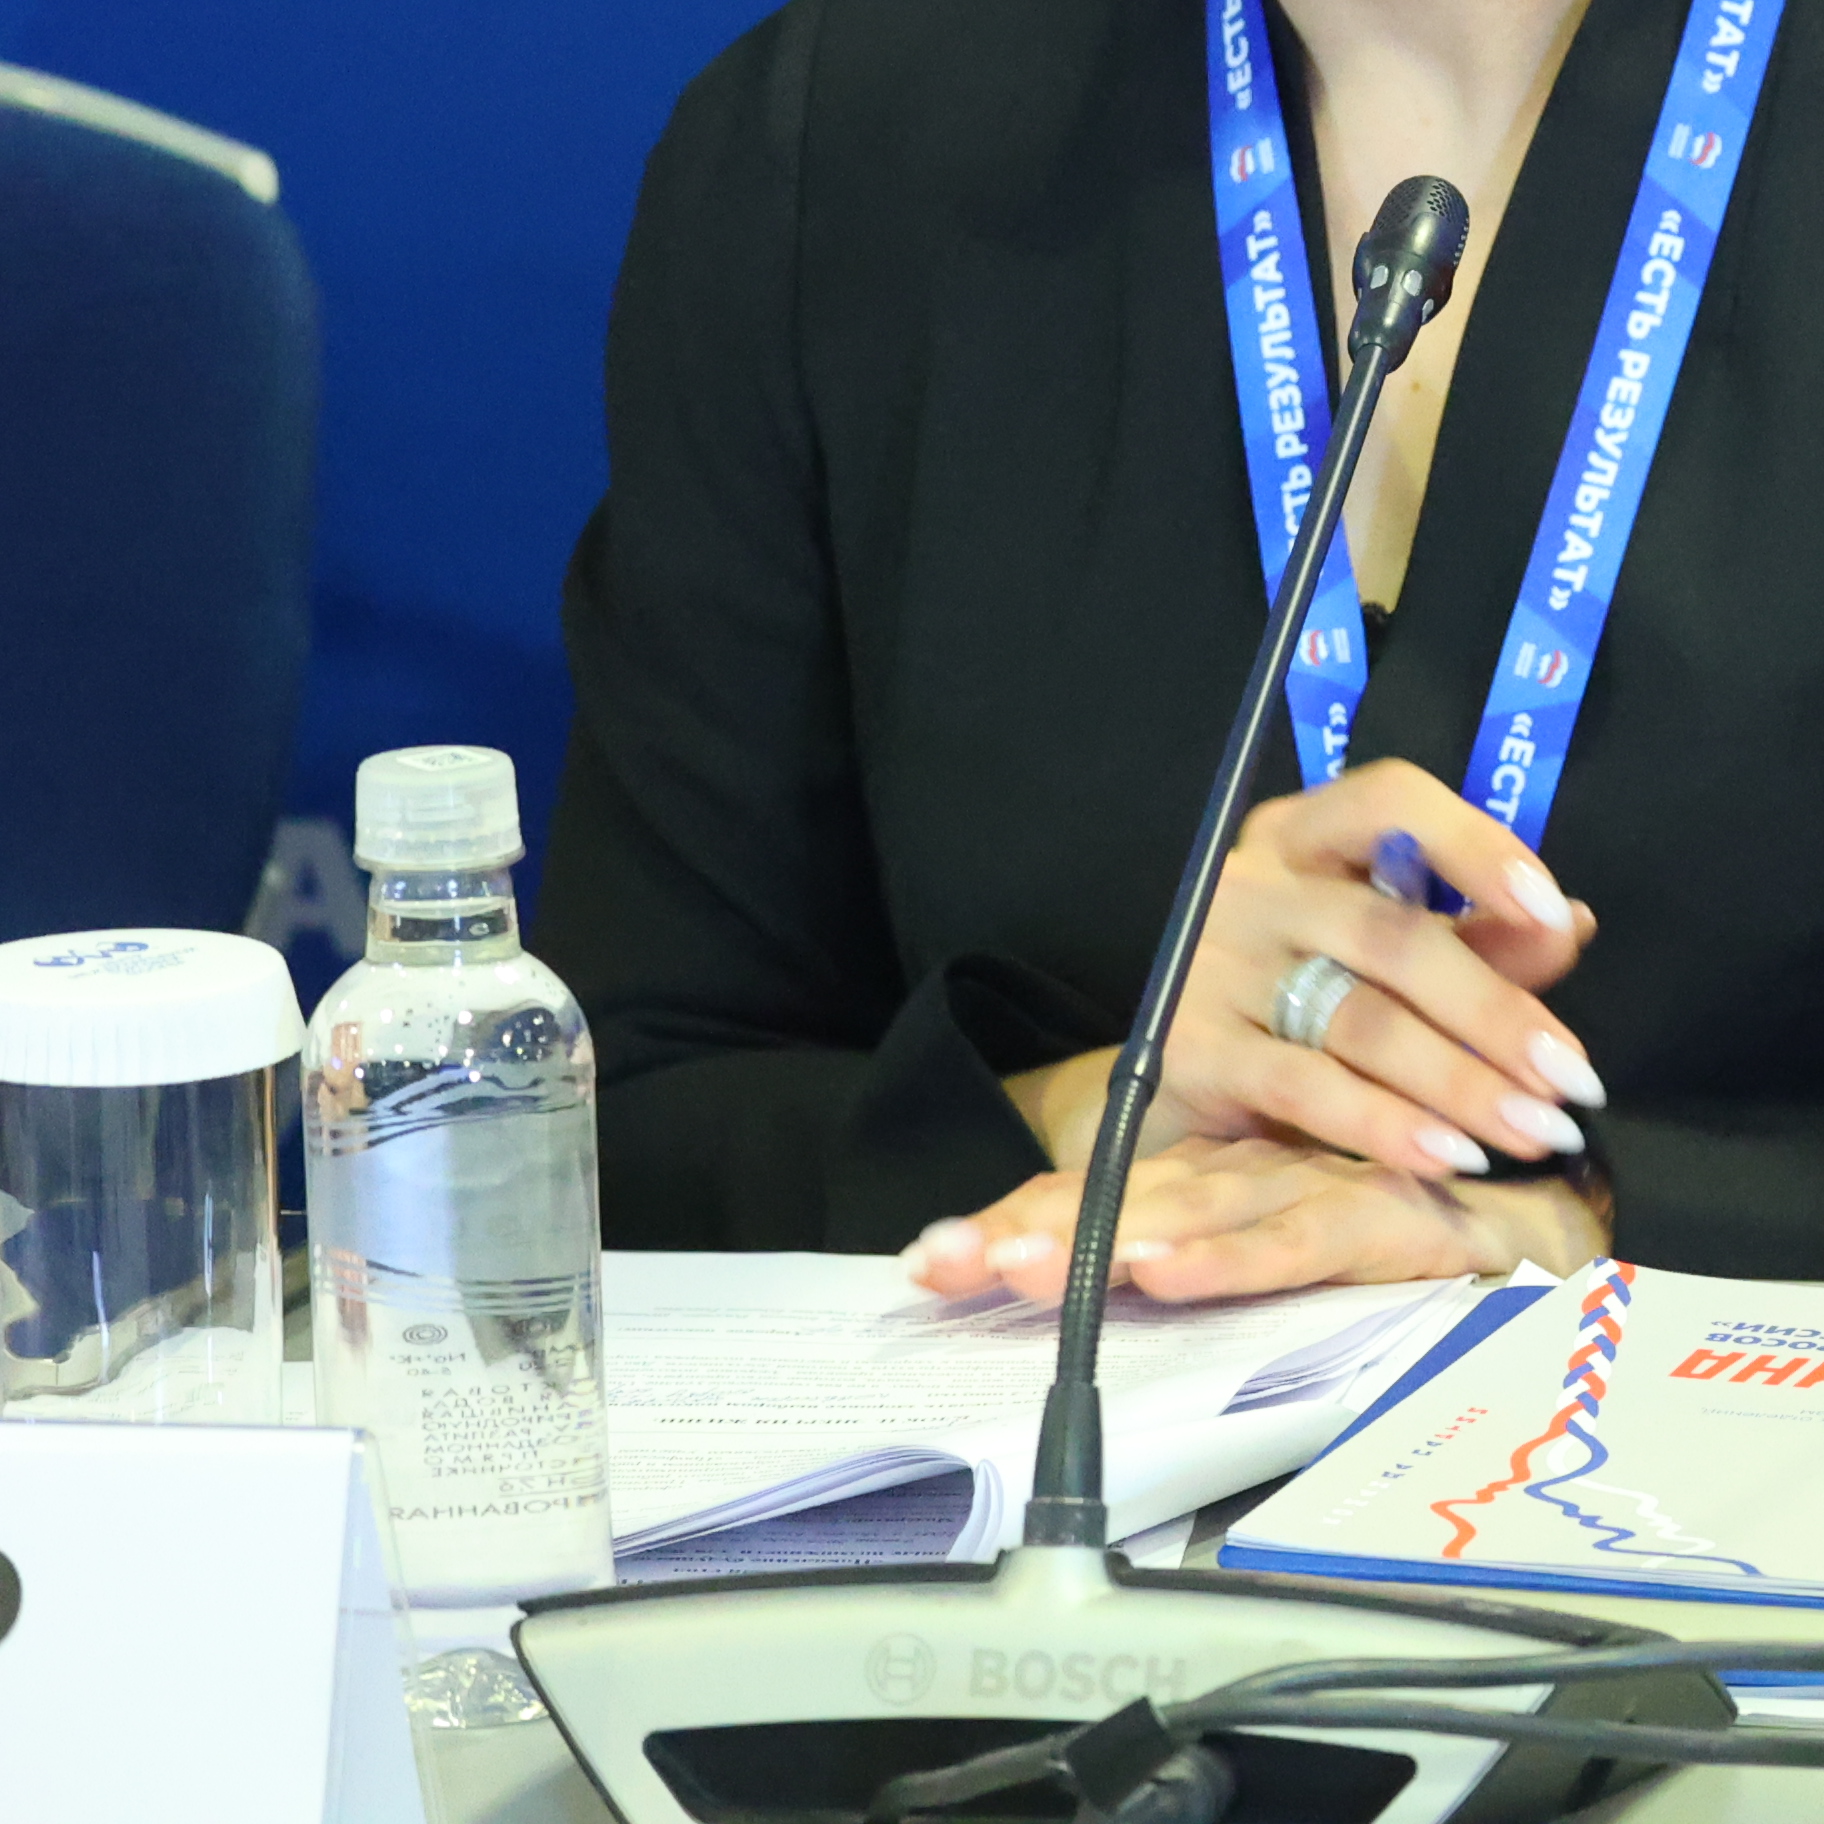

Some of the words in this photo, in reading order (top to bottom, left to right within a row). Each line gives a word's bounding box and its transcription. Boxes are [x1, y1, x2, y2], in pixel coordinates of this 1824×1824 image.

[1248, 210, 1308, 459] РЕЗУЛЬТАТ»
[1626, 210, 1685, 340] «ЕСТЬ
[1548, 347, 1649, 612] РЕЗУЛЬТАТ»
[968, 1647, 1188, 1704] BOSCH
